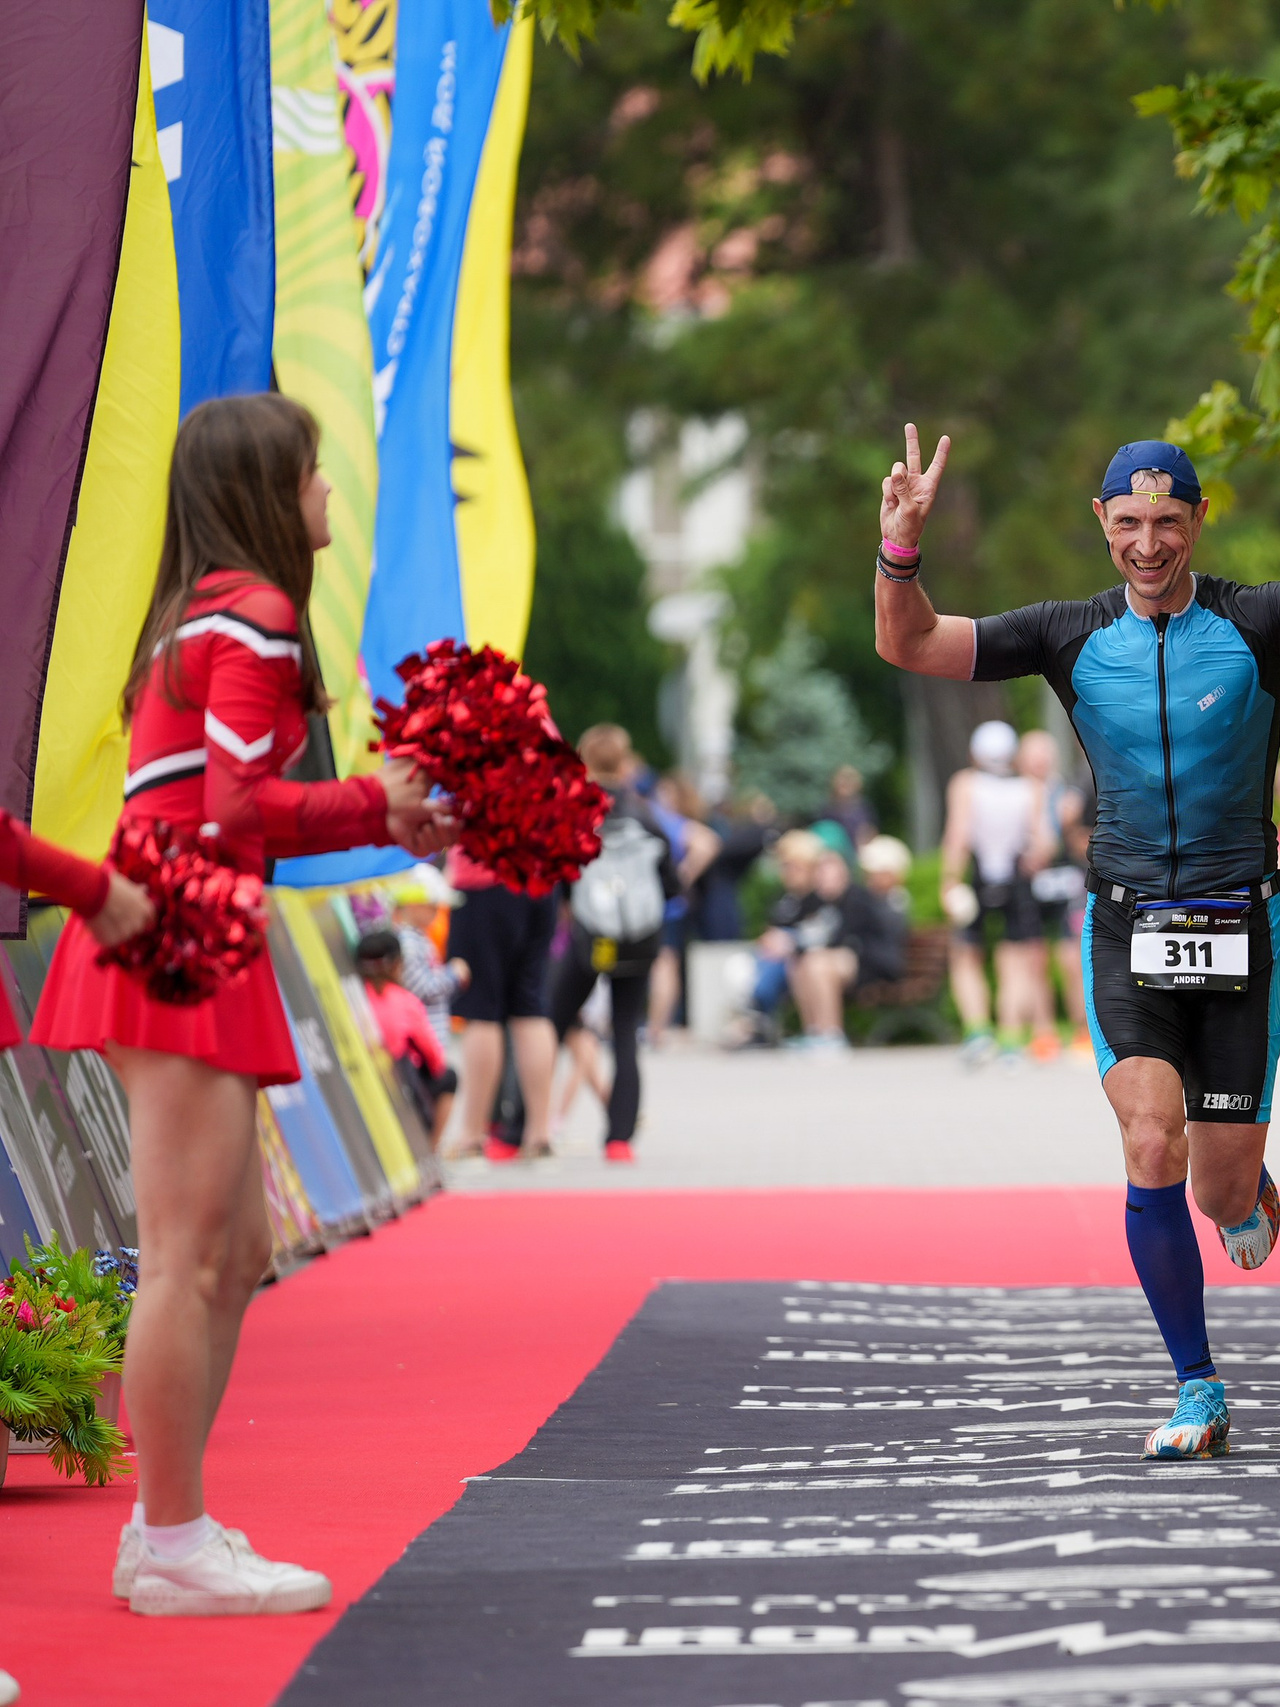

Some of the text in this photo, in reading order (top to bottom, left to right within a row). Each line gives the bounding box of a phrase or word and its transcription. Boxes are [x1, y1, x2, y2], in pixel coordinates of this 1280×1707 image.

[1171, 914, 1209, 923] IRON STAR
[1164, 940, 1213, 968] 311
[1173, 976, 1206, 984] ANDREY
